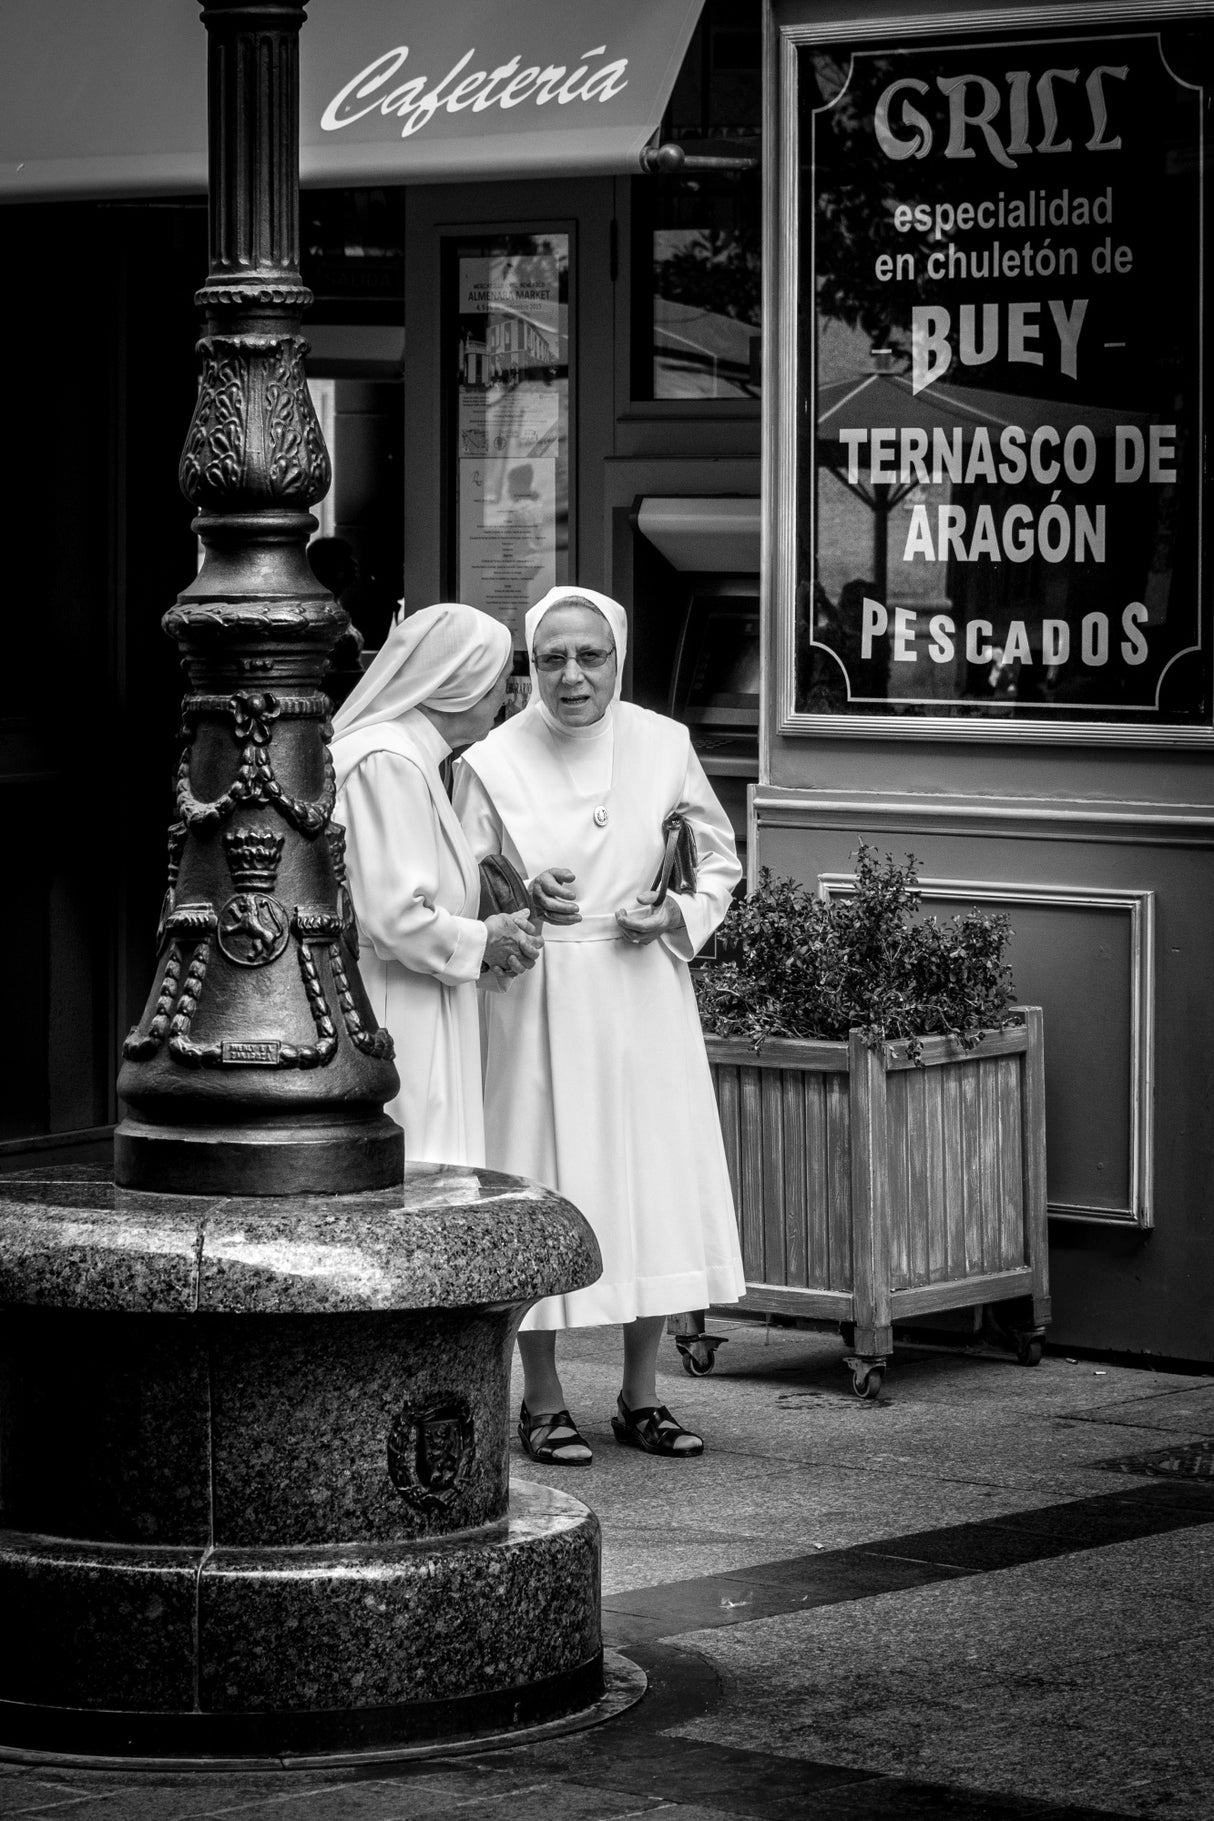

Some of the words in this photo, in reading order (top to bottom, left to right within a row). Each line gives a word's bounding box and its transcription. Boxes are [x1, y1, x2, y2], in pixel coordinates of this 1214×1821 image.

[320, 45, 629, 138] Cafetería
[873, 65, 1130, 169] GRILL
[893, 187, 1113, 240] especialidad
[874, 253, 915, 282] en
[927, 238, 1078, 280] chuletón
[1091, 237, 1133, 274] de
[515, 290, 550, 300] MARKET
[912, 299, 1089, 396] BUEY
[839, 424, 1097, 485] TERNASCO
[1115, 424, 1177, 484] DE
[902, 490, 1106, 563] ARAGÓN
[861, 597, 1149, 666] PESCADOS
